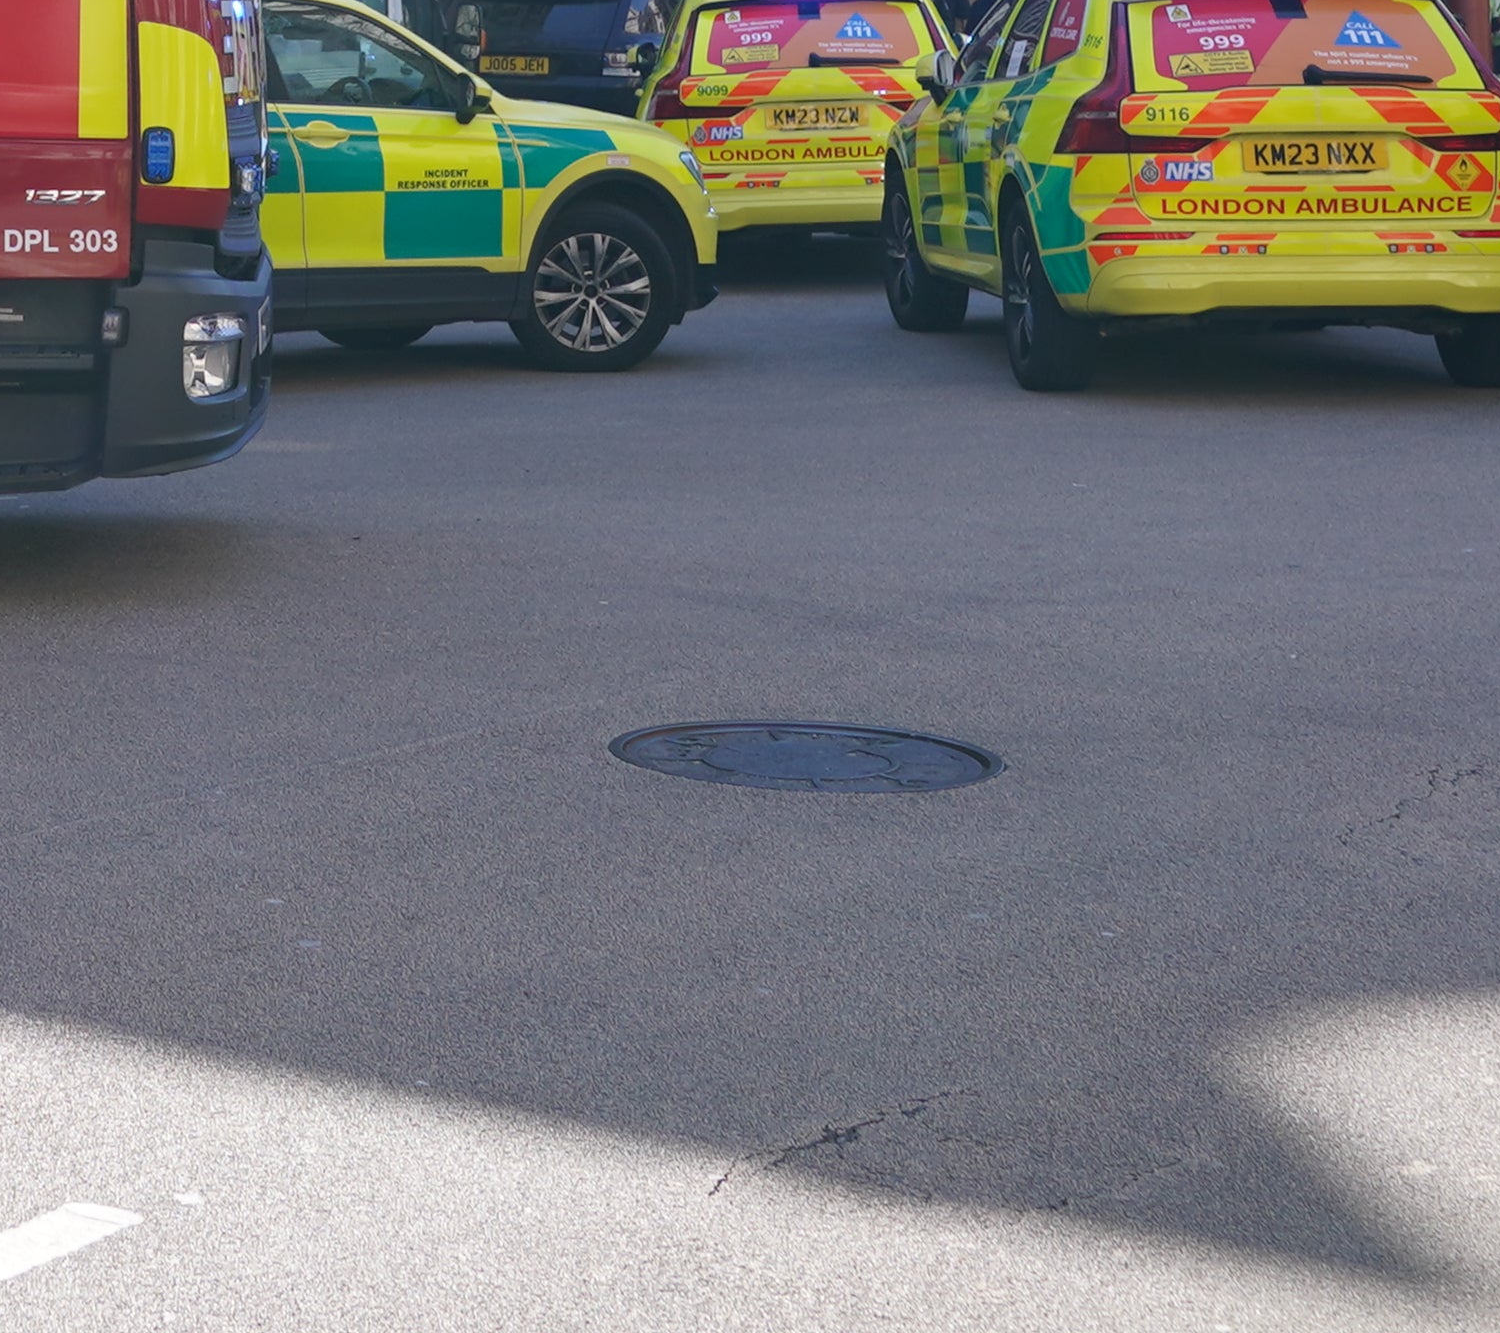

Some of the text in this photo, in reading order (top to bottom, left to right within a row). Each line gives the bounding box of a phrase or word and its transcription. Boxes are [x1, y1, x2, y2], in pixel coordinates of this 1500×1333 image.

[843, 25, 873, 38] 111
[1345, 21, 1375, 30] CALL
[740, 31, 773, 45] 999
[1199, 33, 1246, 51] 999
[1343, 29, 1385, 45] 111
[520, 58, 545, 72] JEH
[696, 84, 729, 97] 9099
[773, 107, 860, 126] KM23 NZW
[1145, 106, 1190, 122] 9116
[710, 126, 743, 140] NHS
[709, 145, 886, 162] LONDON AMBULA
[1253, 141, 1377, 167] KM23 NXX
[424, 168, 469, 178] INCIDENT
[1164, 161, 1213, 181] NHS
[397, 179, 489, 190] RESPONSE OFFICER
[1160, 195, 1472, 216] LONDON AMBULANCE
[3, 228, 118, 254] DPL 303
